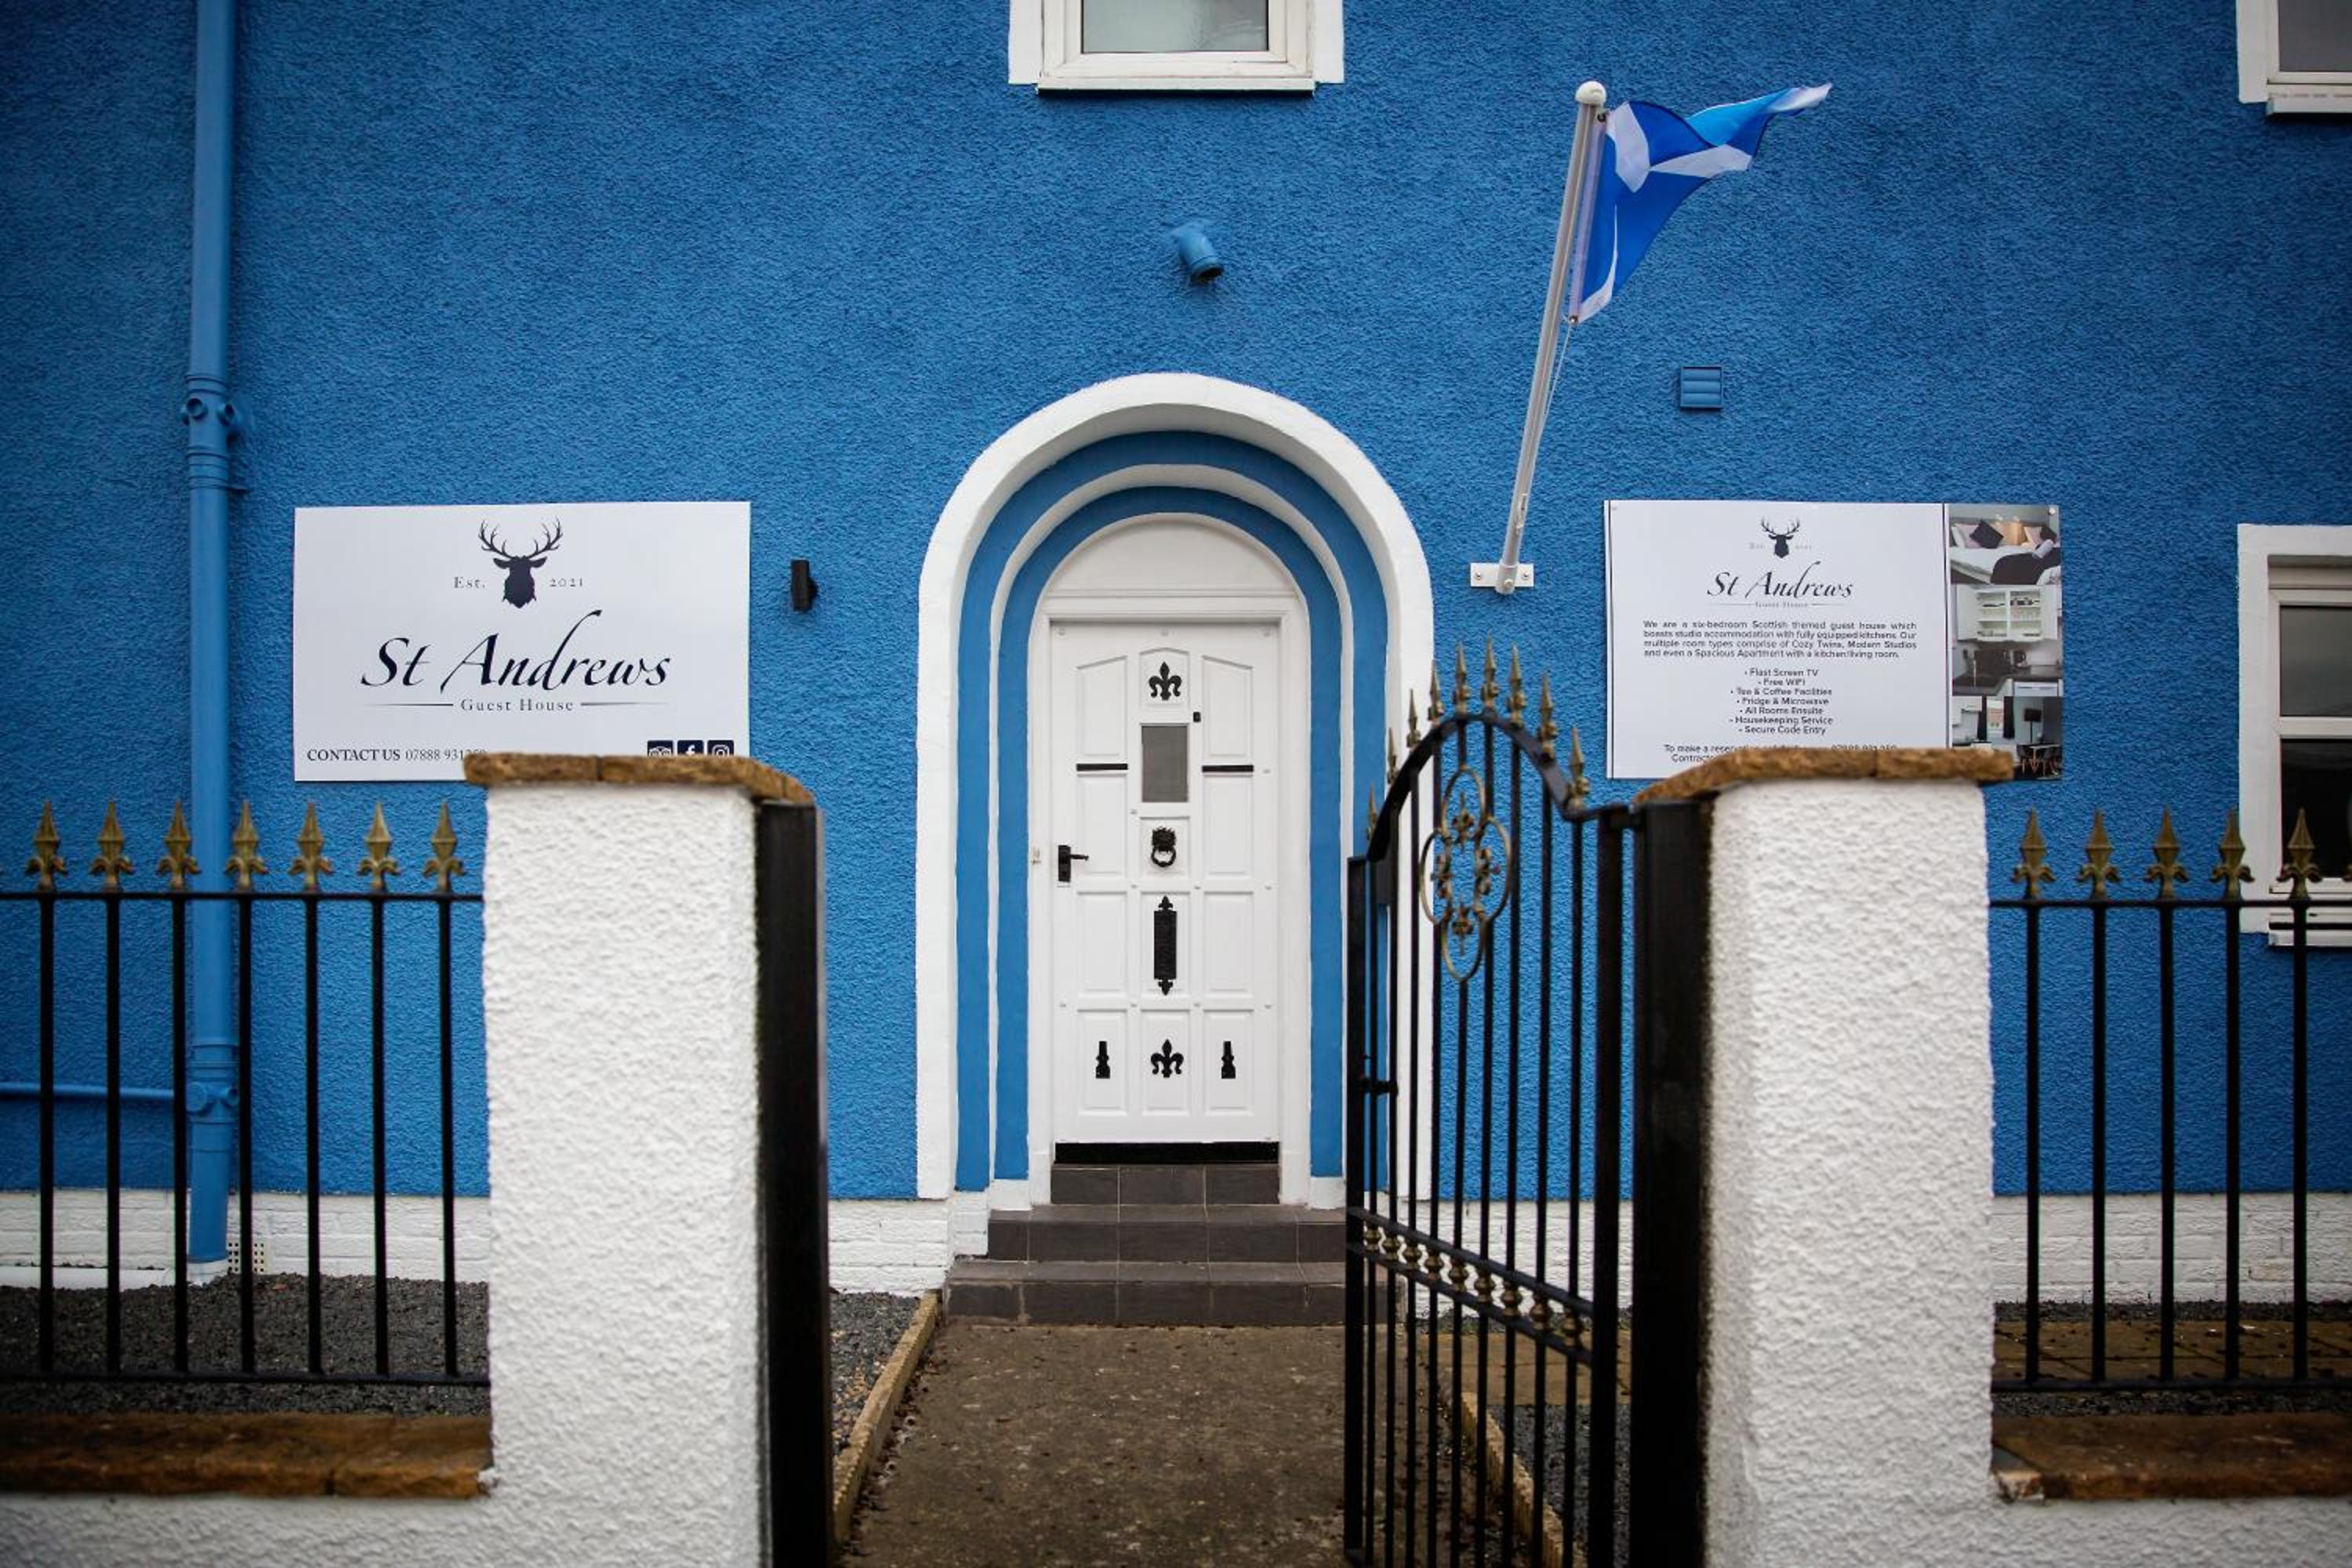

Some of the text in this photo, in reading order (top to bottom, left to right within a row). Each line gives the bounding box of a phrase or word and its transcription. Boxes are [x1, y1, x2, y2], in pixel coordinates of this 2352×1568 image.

[454, 576, 583, 589] Est. 2021
[1707, 561, 1853, 599] St Andrews
[1831, 622, 1855, 630] guest
[1643, 640, 1680, 648] multiple
[1682, 641, 1706, 649] room
[1708, 641, 1733, 649] types
[1737, 641, 1777, 649] comprise
[1780, 641, 1788, 649] of
[1791, 641, 1814, 649] Cozy
[1847, 641, 1881, 649] Modern
[1884, 641, 1917, 649] Studios
[361, 609, 671, 694] St Andrews
[1643, 648, 1661, 657] and
[1663, 649, 1685, 658] even
[1694, 649, 1735, 659] Spacious
[1737, 649, 1784, 659] Apartment
[1786, 649, 1804, 658] with
[1763, 677, 1784, 687] Free
[1737, 687, 1752, 696] Tea
[1762, 687, 1791, 696] Coffee
[1795, 687, 1832, 696] Facilities
[460, 698, 575, 711] Guest House
[1735, 717, 1834, 726] Housekeeping Service
[1803, 726, 1826, 735] Entry
[1664, 744, 1675, 753] To
[307, 749, 379, 761] CONTACT
[382, 749, 401, 761] US
[405, 749, 441, 761] 07888
